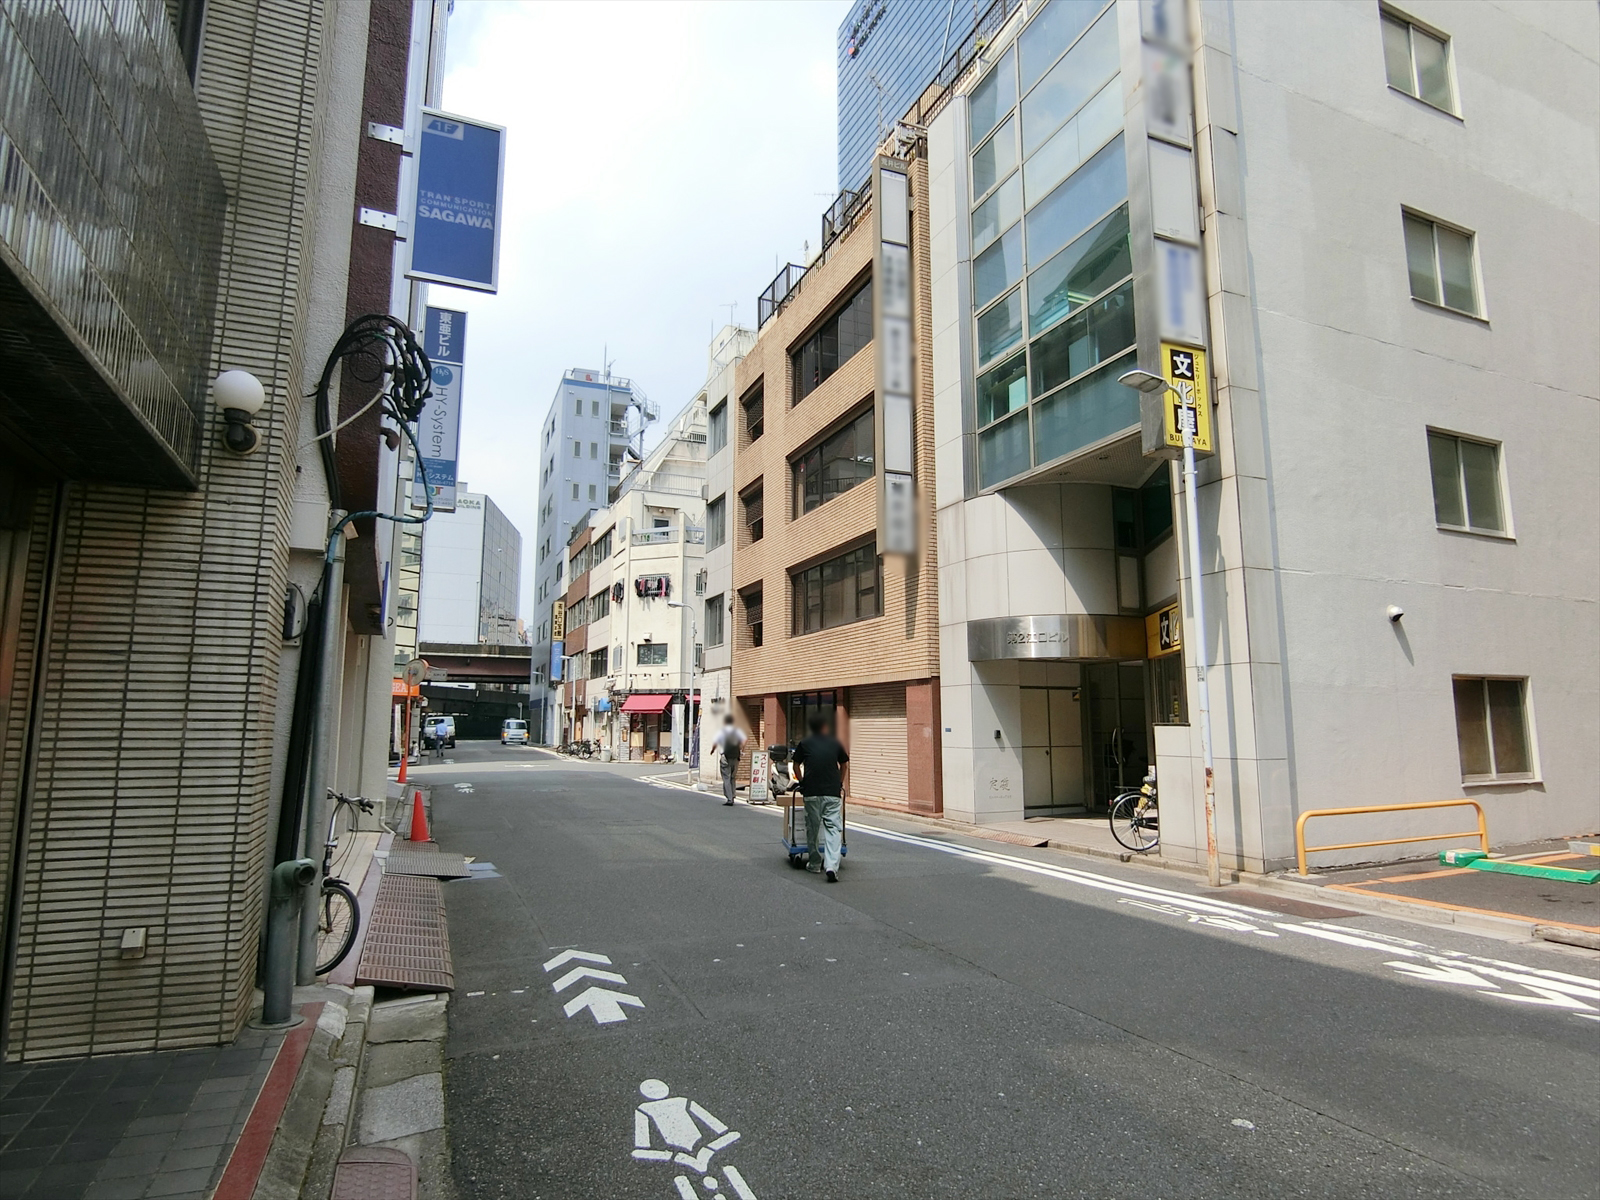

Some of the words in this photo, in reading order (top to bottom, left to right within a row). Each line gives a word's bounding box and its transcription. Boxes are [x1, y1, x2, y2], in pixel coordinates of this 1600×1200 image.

[435, 121, 453, 133] 1F
[418, 205, 493, 230] SAGAWA
[437, 311, 453, 357] 東亜ビル
[1173, 353, 1196, 433] 文化屋
[431, 387, 448, 458] HY-System
[1169, 433, 1207, 445] BUAYA
